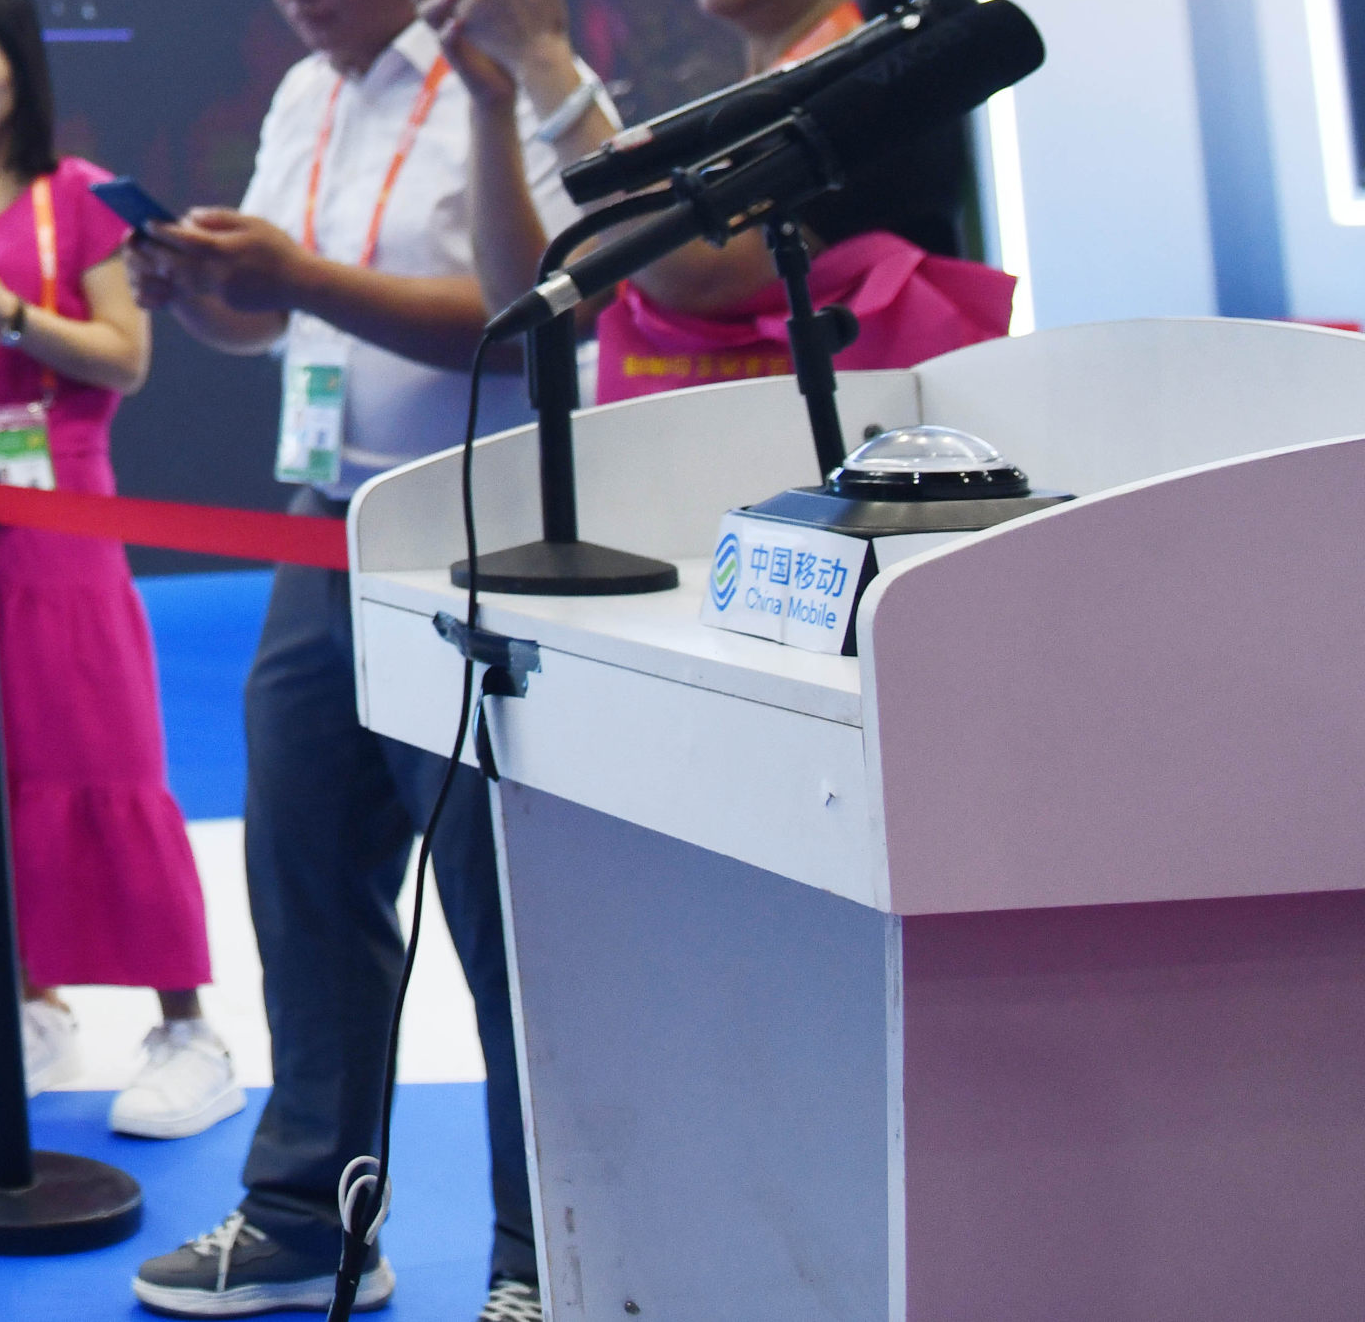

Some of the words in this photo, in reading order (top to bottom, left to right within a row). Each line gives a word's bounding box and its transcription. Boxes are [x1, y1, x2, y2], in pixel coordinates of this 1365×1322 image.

[750, 544, 848, 597] 中国移动
[746, 587, 782, 615] China
[788, 596, 837, 629] Mobile
